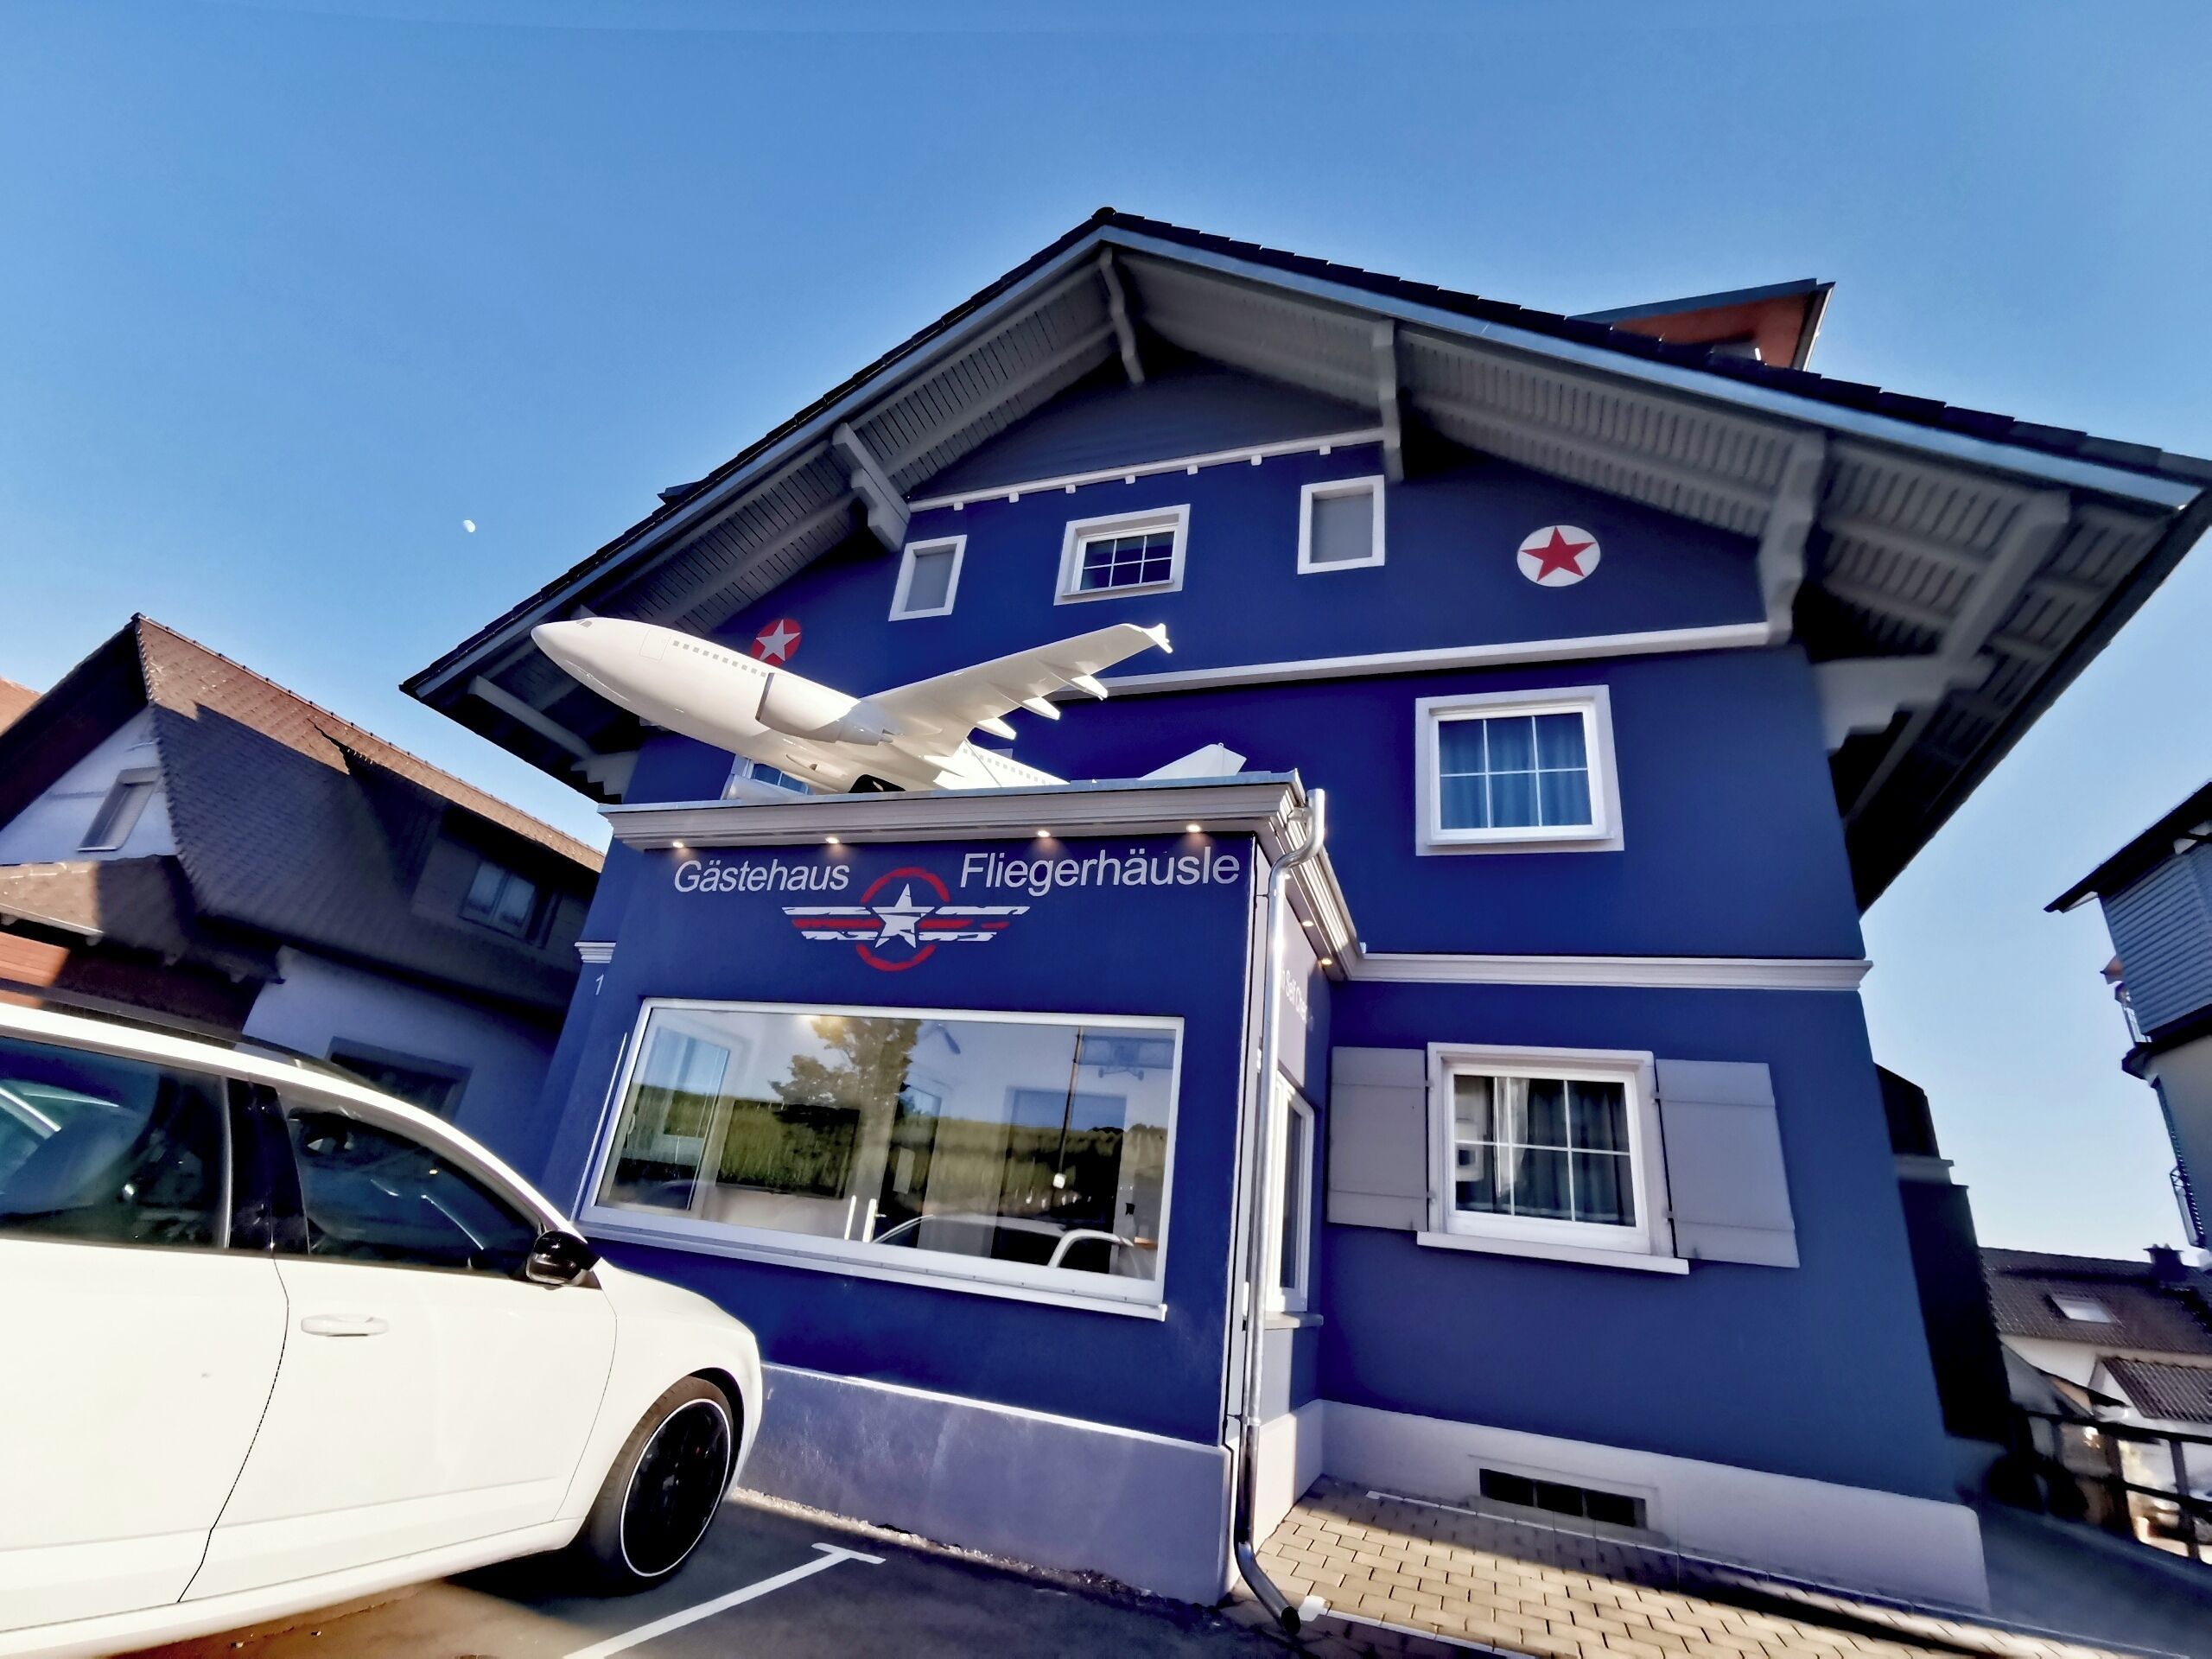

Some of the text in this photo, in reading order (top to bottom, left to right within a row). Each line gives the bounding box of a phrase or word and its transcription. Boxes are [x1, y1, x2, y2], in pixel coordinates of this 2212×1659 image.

[674, 846, 1240, 897] Gästehaus Fliegerhäusle
[595, 973, 605, 996] 1
